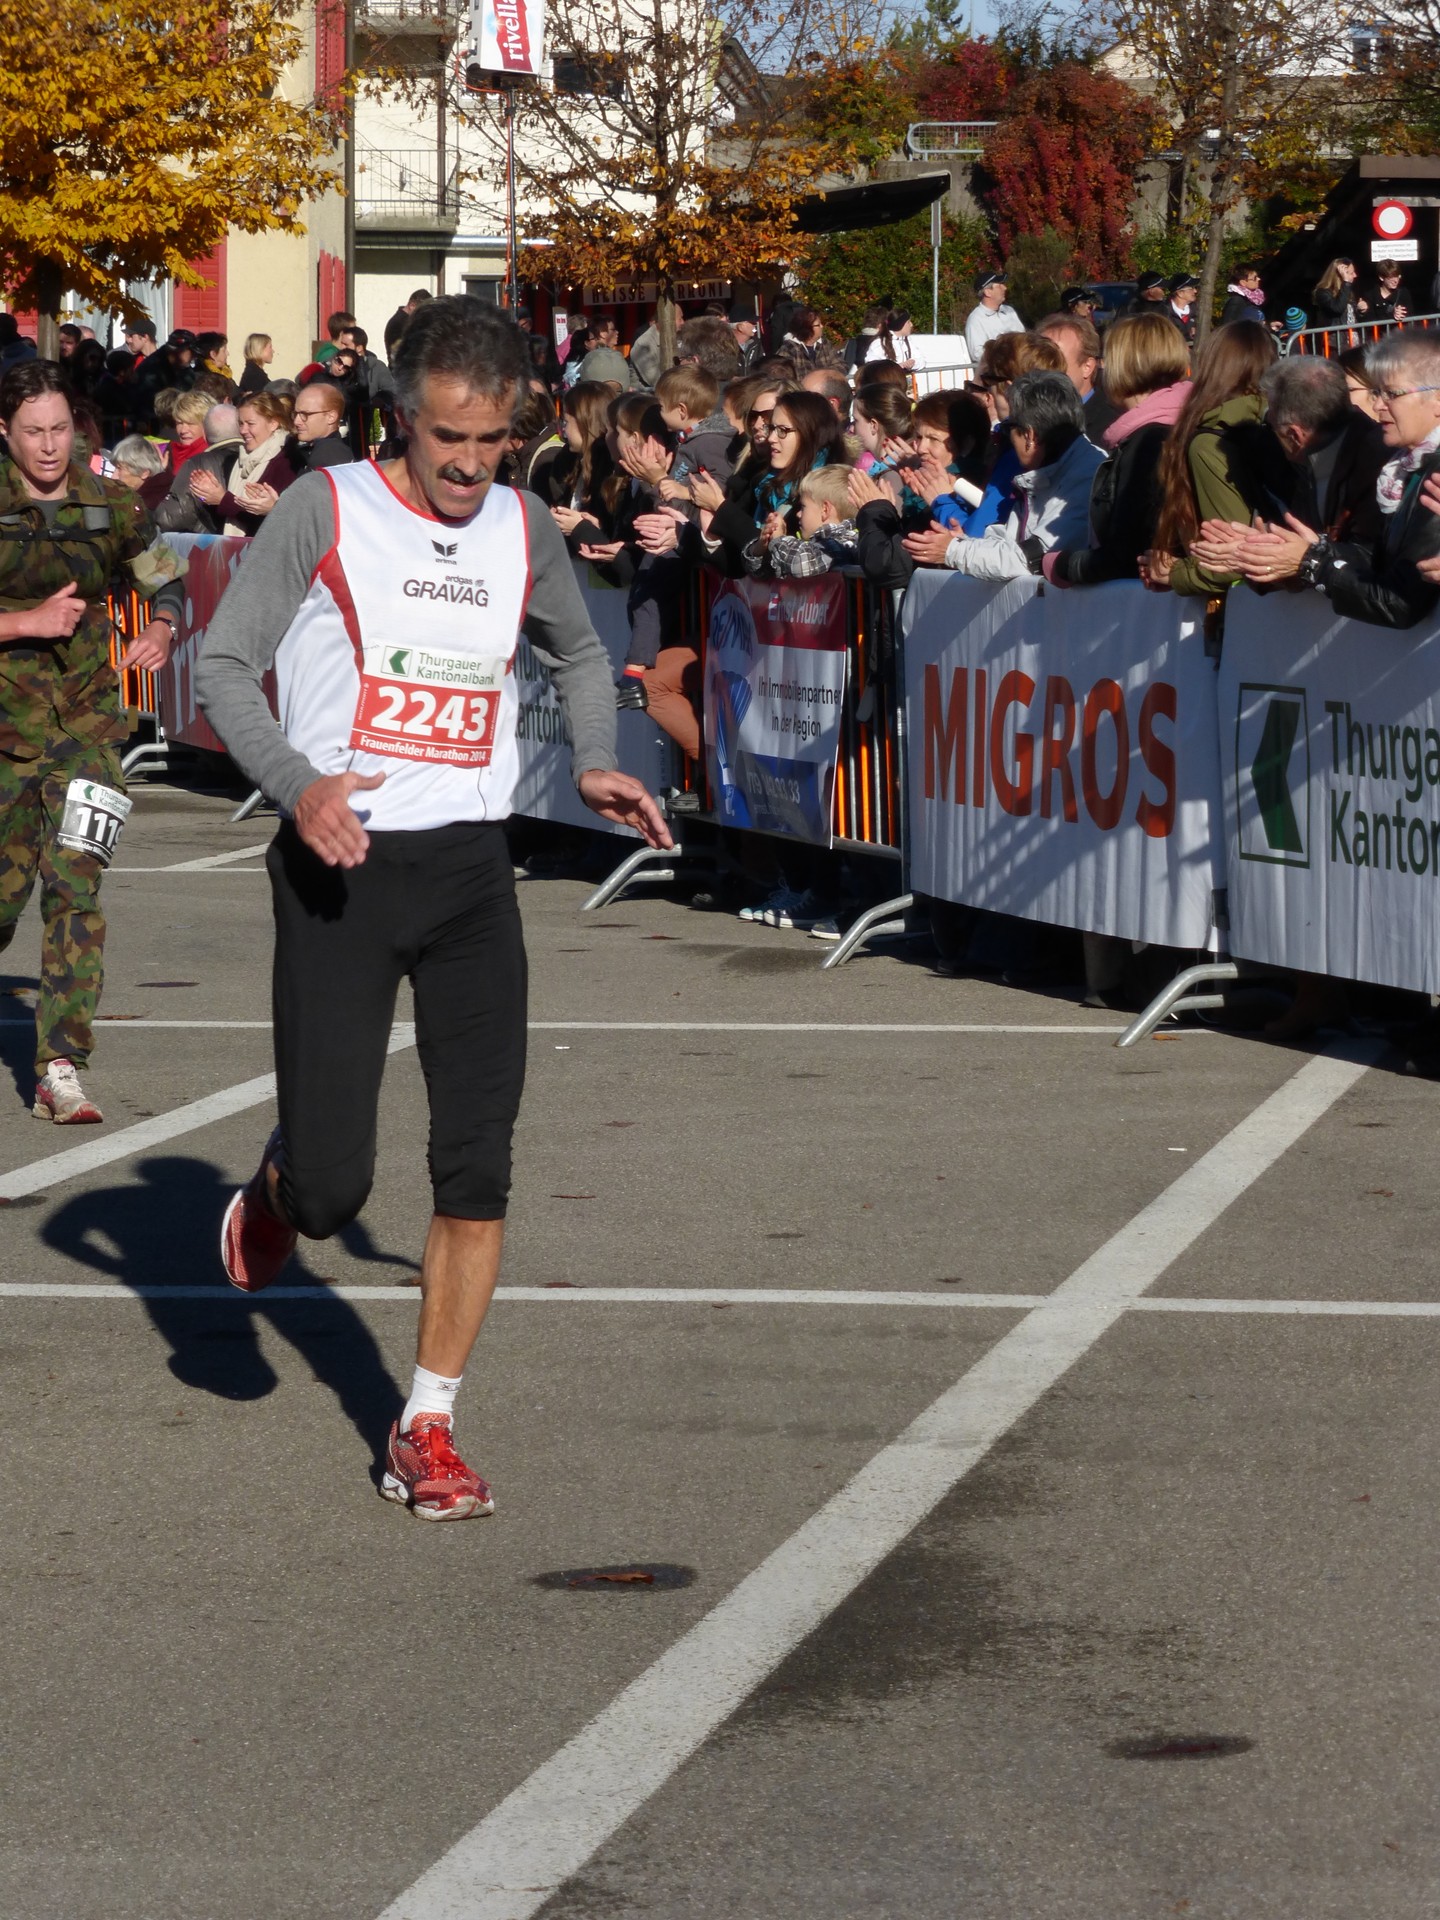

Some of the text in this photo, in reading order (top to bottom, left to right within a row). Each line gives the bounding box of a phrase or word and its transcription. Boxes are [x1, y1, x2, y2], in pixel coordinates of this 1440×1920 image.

[592, 285, 646, 303] HEISSE
[435, 557, 458, 566] erima
[445, 575, 473, 586] erdgas
[402, 579, 489, 608] GRAVAG
[797, 595, 830, 625] Huber
[418, 652, 482, 671] Thurgauer
[416, 665, 496, 686] Kantonalbank
[370, 685, 490, 742] 2243
[772, 709, 779, 731] in
[360, 735, 486, 763] Frauenfelder Marathon 2014
[924, 663, 1178, 839] MIGROS
